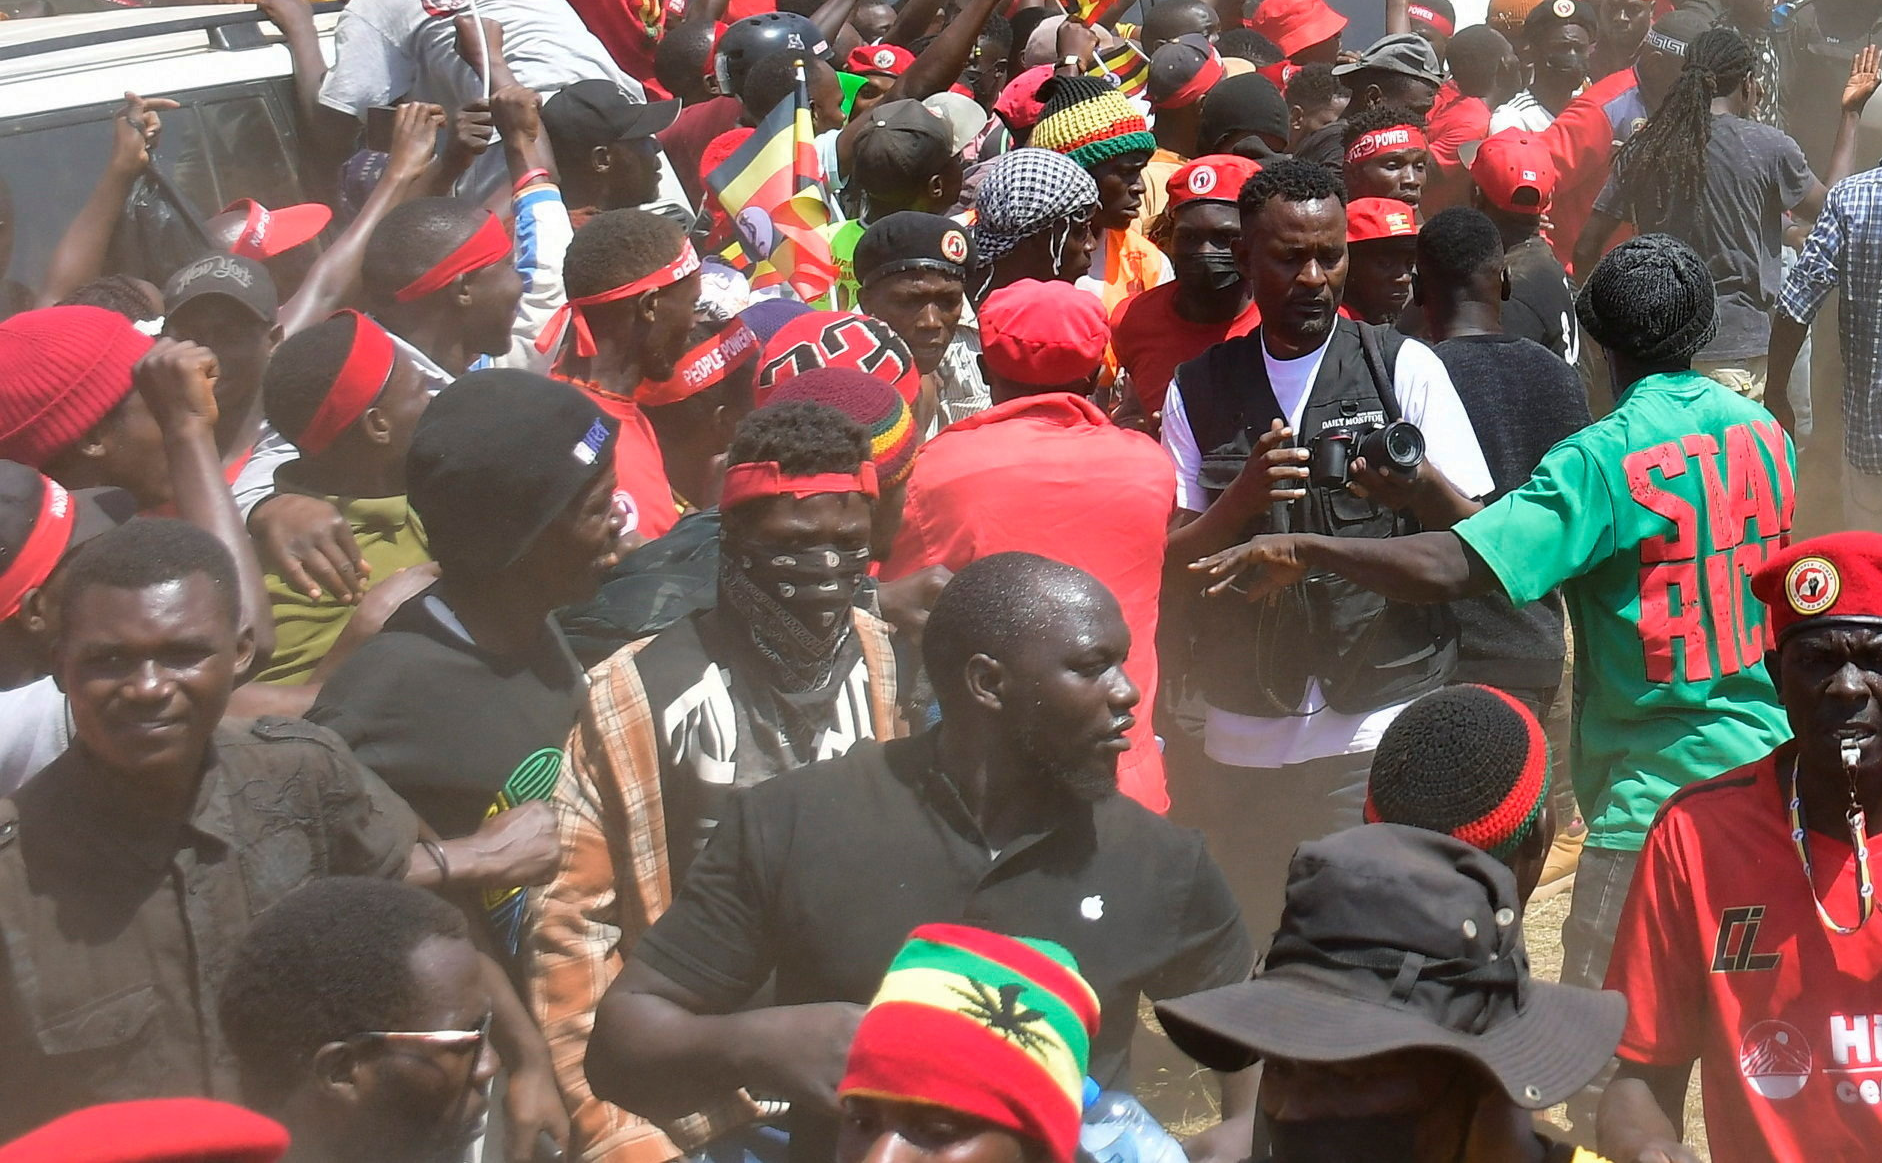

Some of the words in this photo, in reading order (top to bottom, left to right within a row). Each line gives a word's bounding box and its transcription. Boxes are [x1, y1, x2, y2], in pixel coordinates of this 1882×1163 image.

[1408, 5, 1434, 21] POWER
[1374, 130, 1409, 149] POWER
[213, 258, 253, 288] York
[682, 348, 727, 388] PEOPLE
[721, 326, 757, 362] POWER
[1322, 417, 1345, 430] DAILY
[1345, 414, 1385, 427] MONITOR
[1623, 420, 1796, 564] STAY
